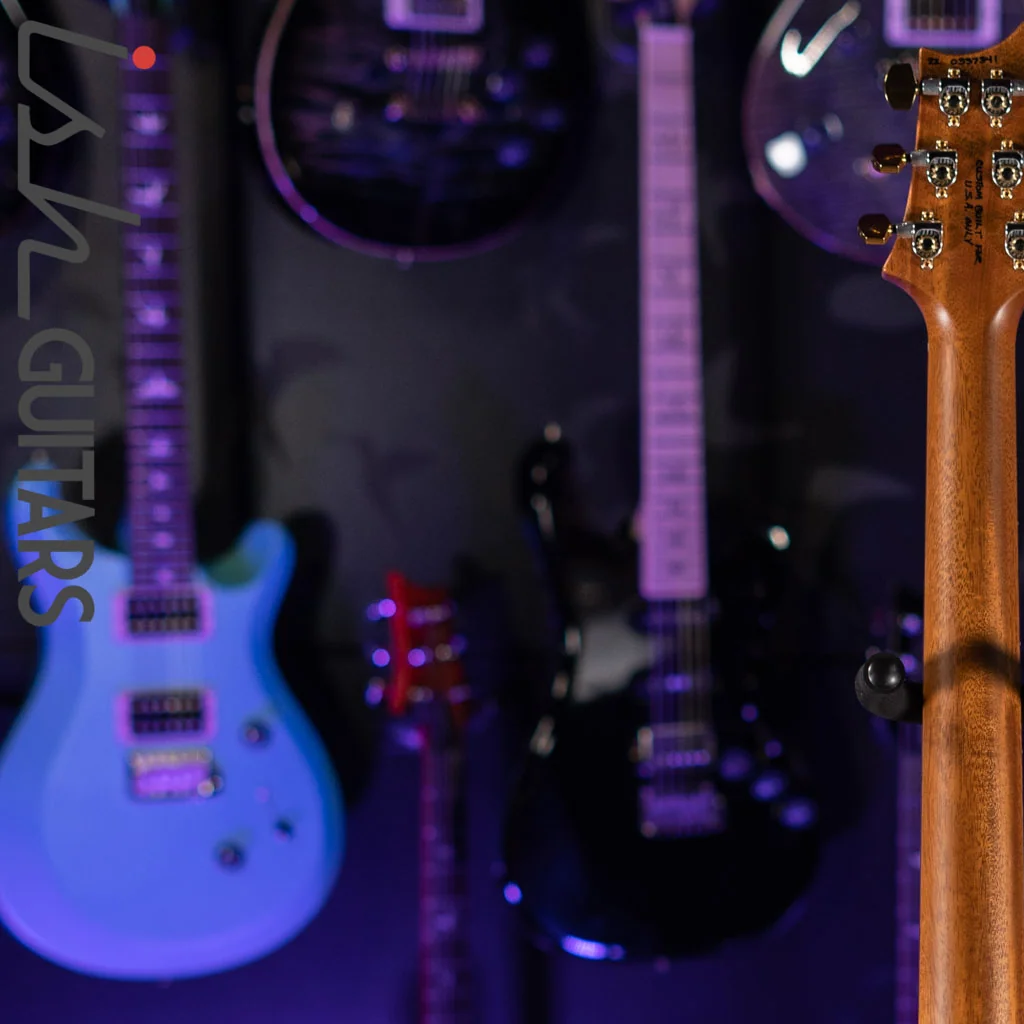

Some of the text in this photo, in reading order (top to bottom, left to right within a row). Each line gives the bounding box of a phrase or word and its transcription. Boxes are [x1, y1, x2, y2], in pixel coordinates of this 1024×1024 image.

[975, 159, 984, 200] CUSTOM
[963, 216, 974, 246] ONLY
[974, 205, 984, 239] BUILT
